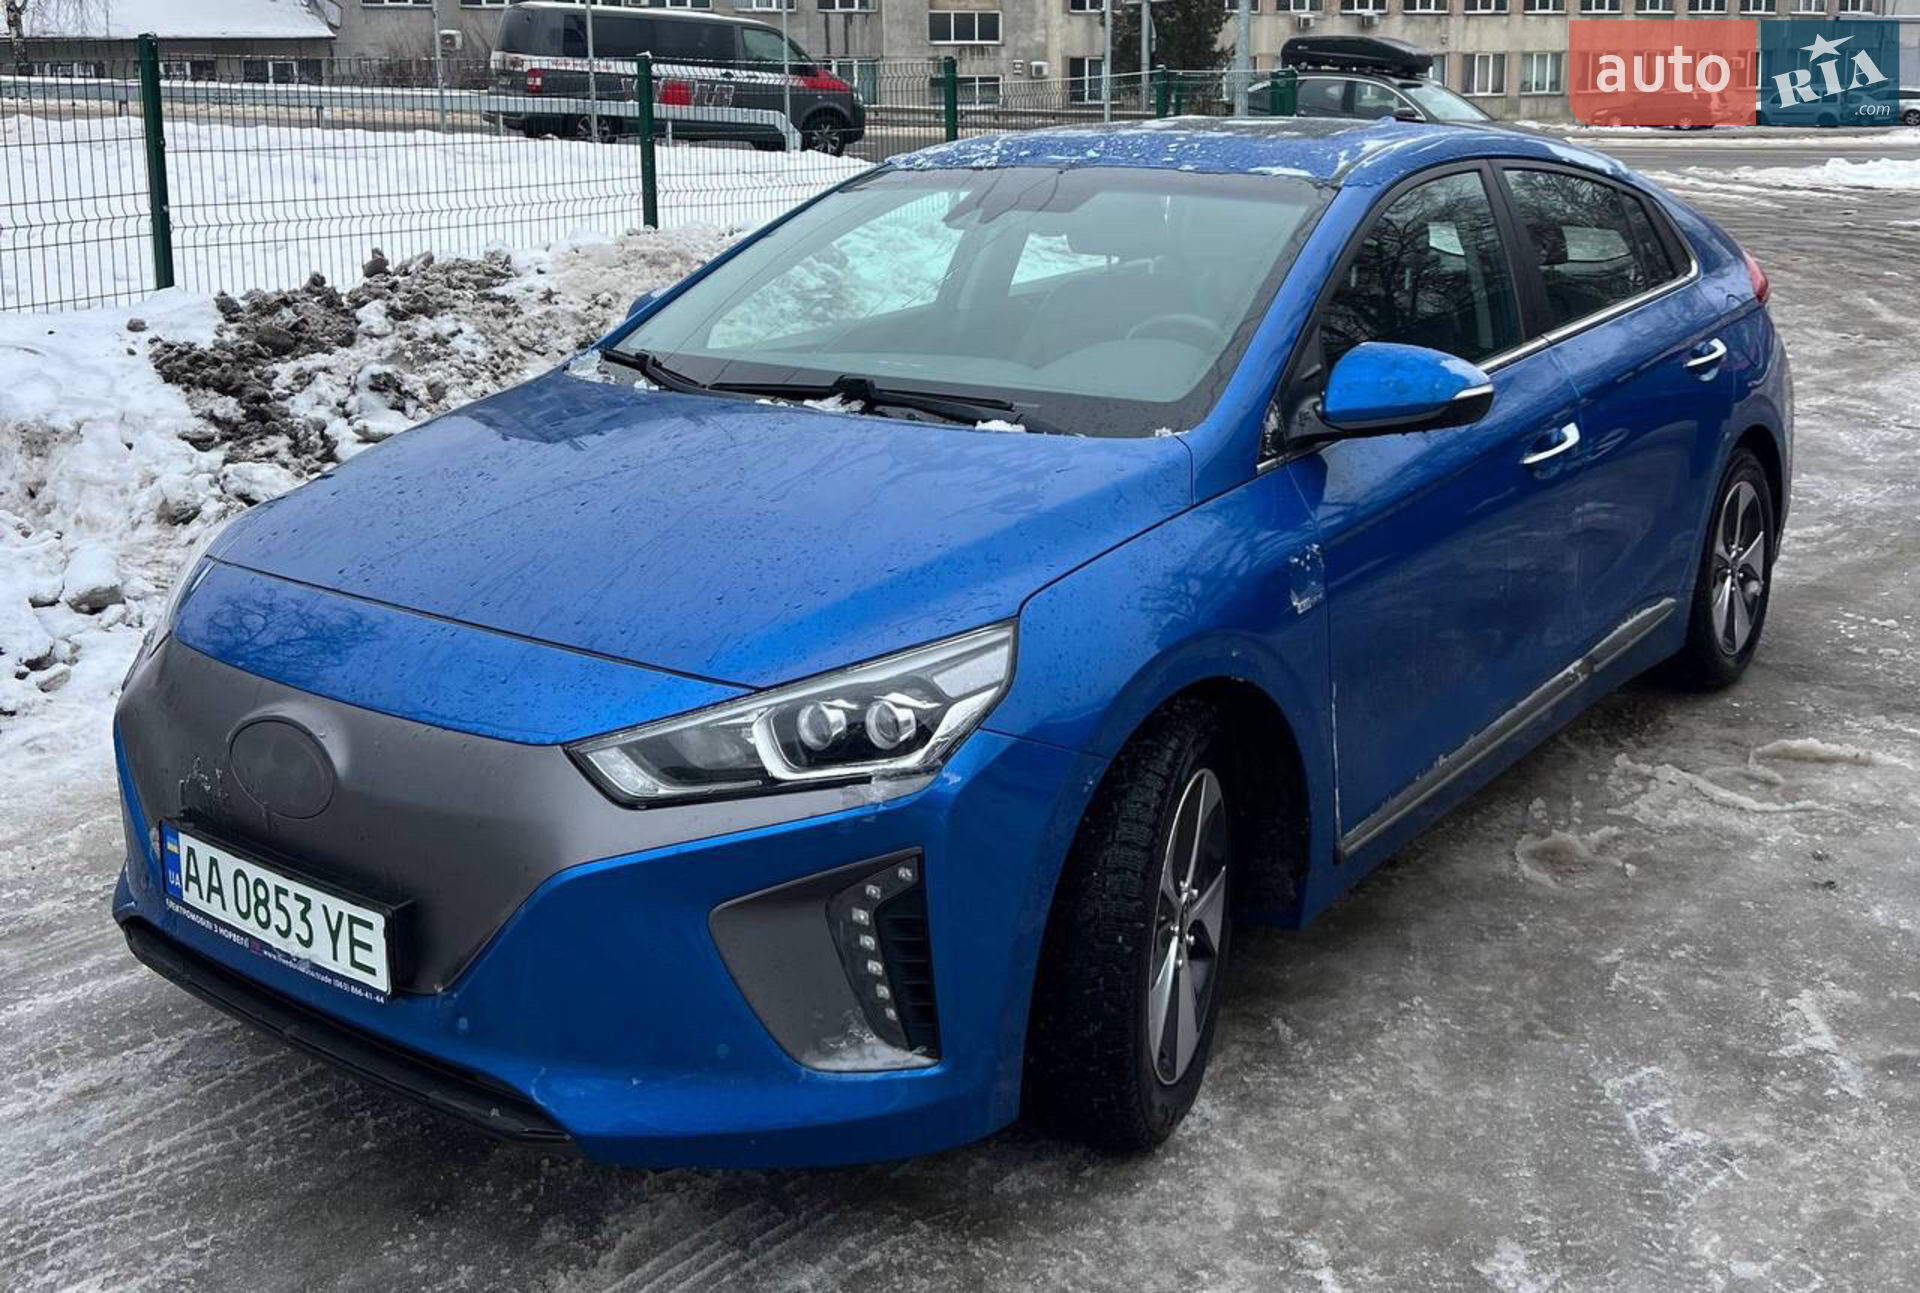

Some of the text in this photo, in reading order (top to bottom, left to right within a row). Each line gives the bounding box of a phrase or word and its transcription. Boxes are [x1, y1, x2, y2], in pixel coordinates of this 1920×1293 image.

[168, 868, 182, 889] UA
[184, 845, 227, 911] AA
[233, 867, 315, 949] 0853
[321, 903, 377, 977] YE
